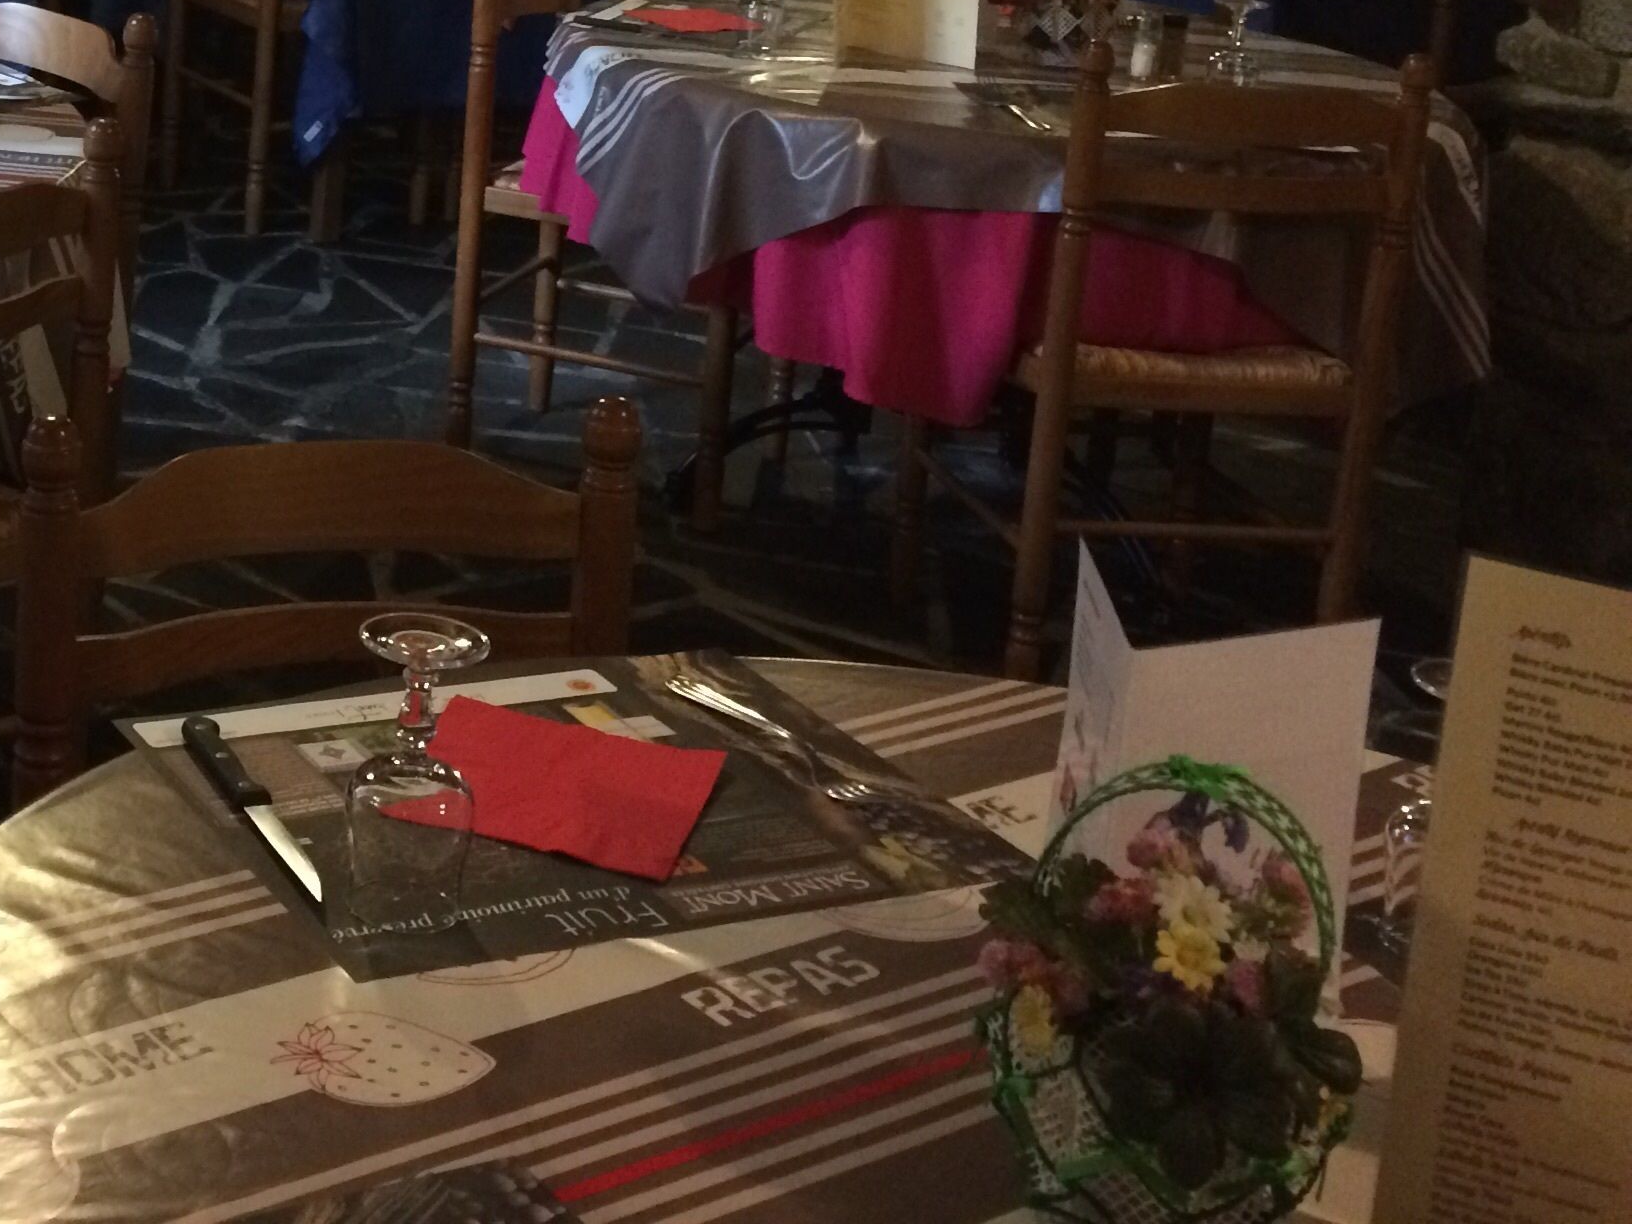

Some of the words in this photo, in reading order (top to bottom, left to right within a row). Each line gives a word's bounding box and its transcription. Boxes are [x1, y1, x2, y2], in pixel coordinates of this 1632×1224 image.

[679, 885, 785, 914] MONT
[786, 870, 871, 898] SAINT
[544, 900, 670, 937] Fruit
[680, 945, 881, 1028] REPAS
[20, 1022, 214, 1098] HOME
